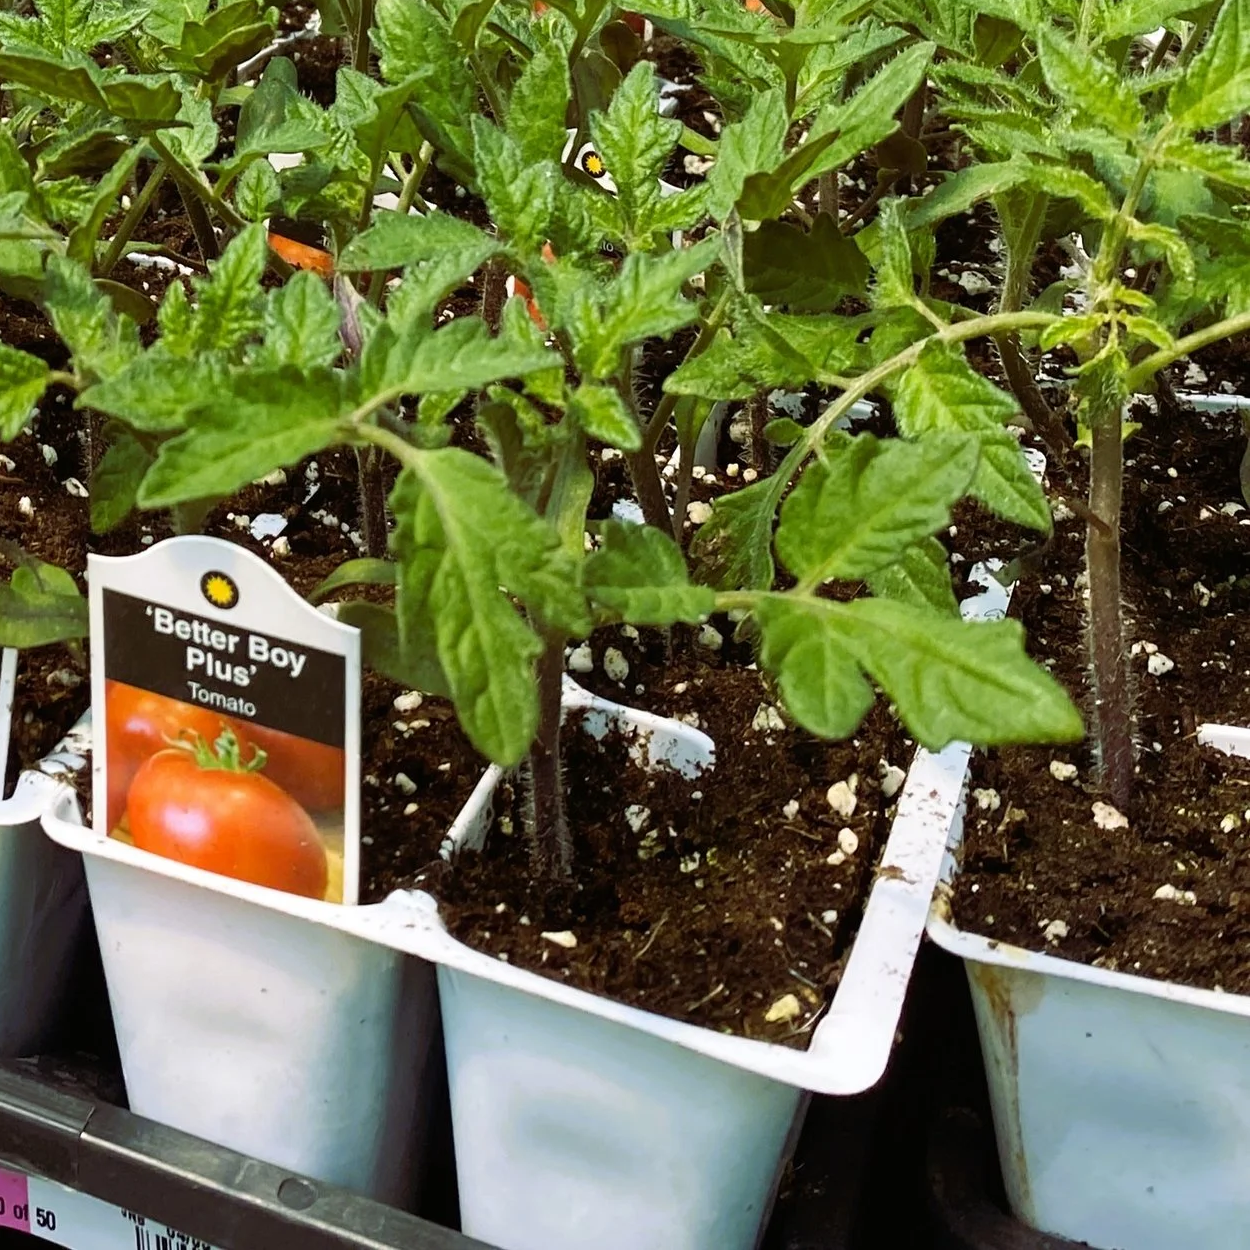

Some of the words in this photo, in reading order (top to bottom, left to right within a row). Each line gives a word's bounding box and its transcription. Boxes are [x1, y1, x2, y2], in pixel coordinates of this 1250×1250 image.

[145, 605, 240, 654] 'Better
[248, 634, 306, 678] Boy
[186, 646, 257, 687] Plus'
[186, 680, 257, 717] Tomato
[13, 1202, 29, 1221] of
[36, 1207, 57, 1231] 50
